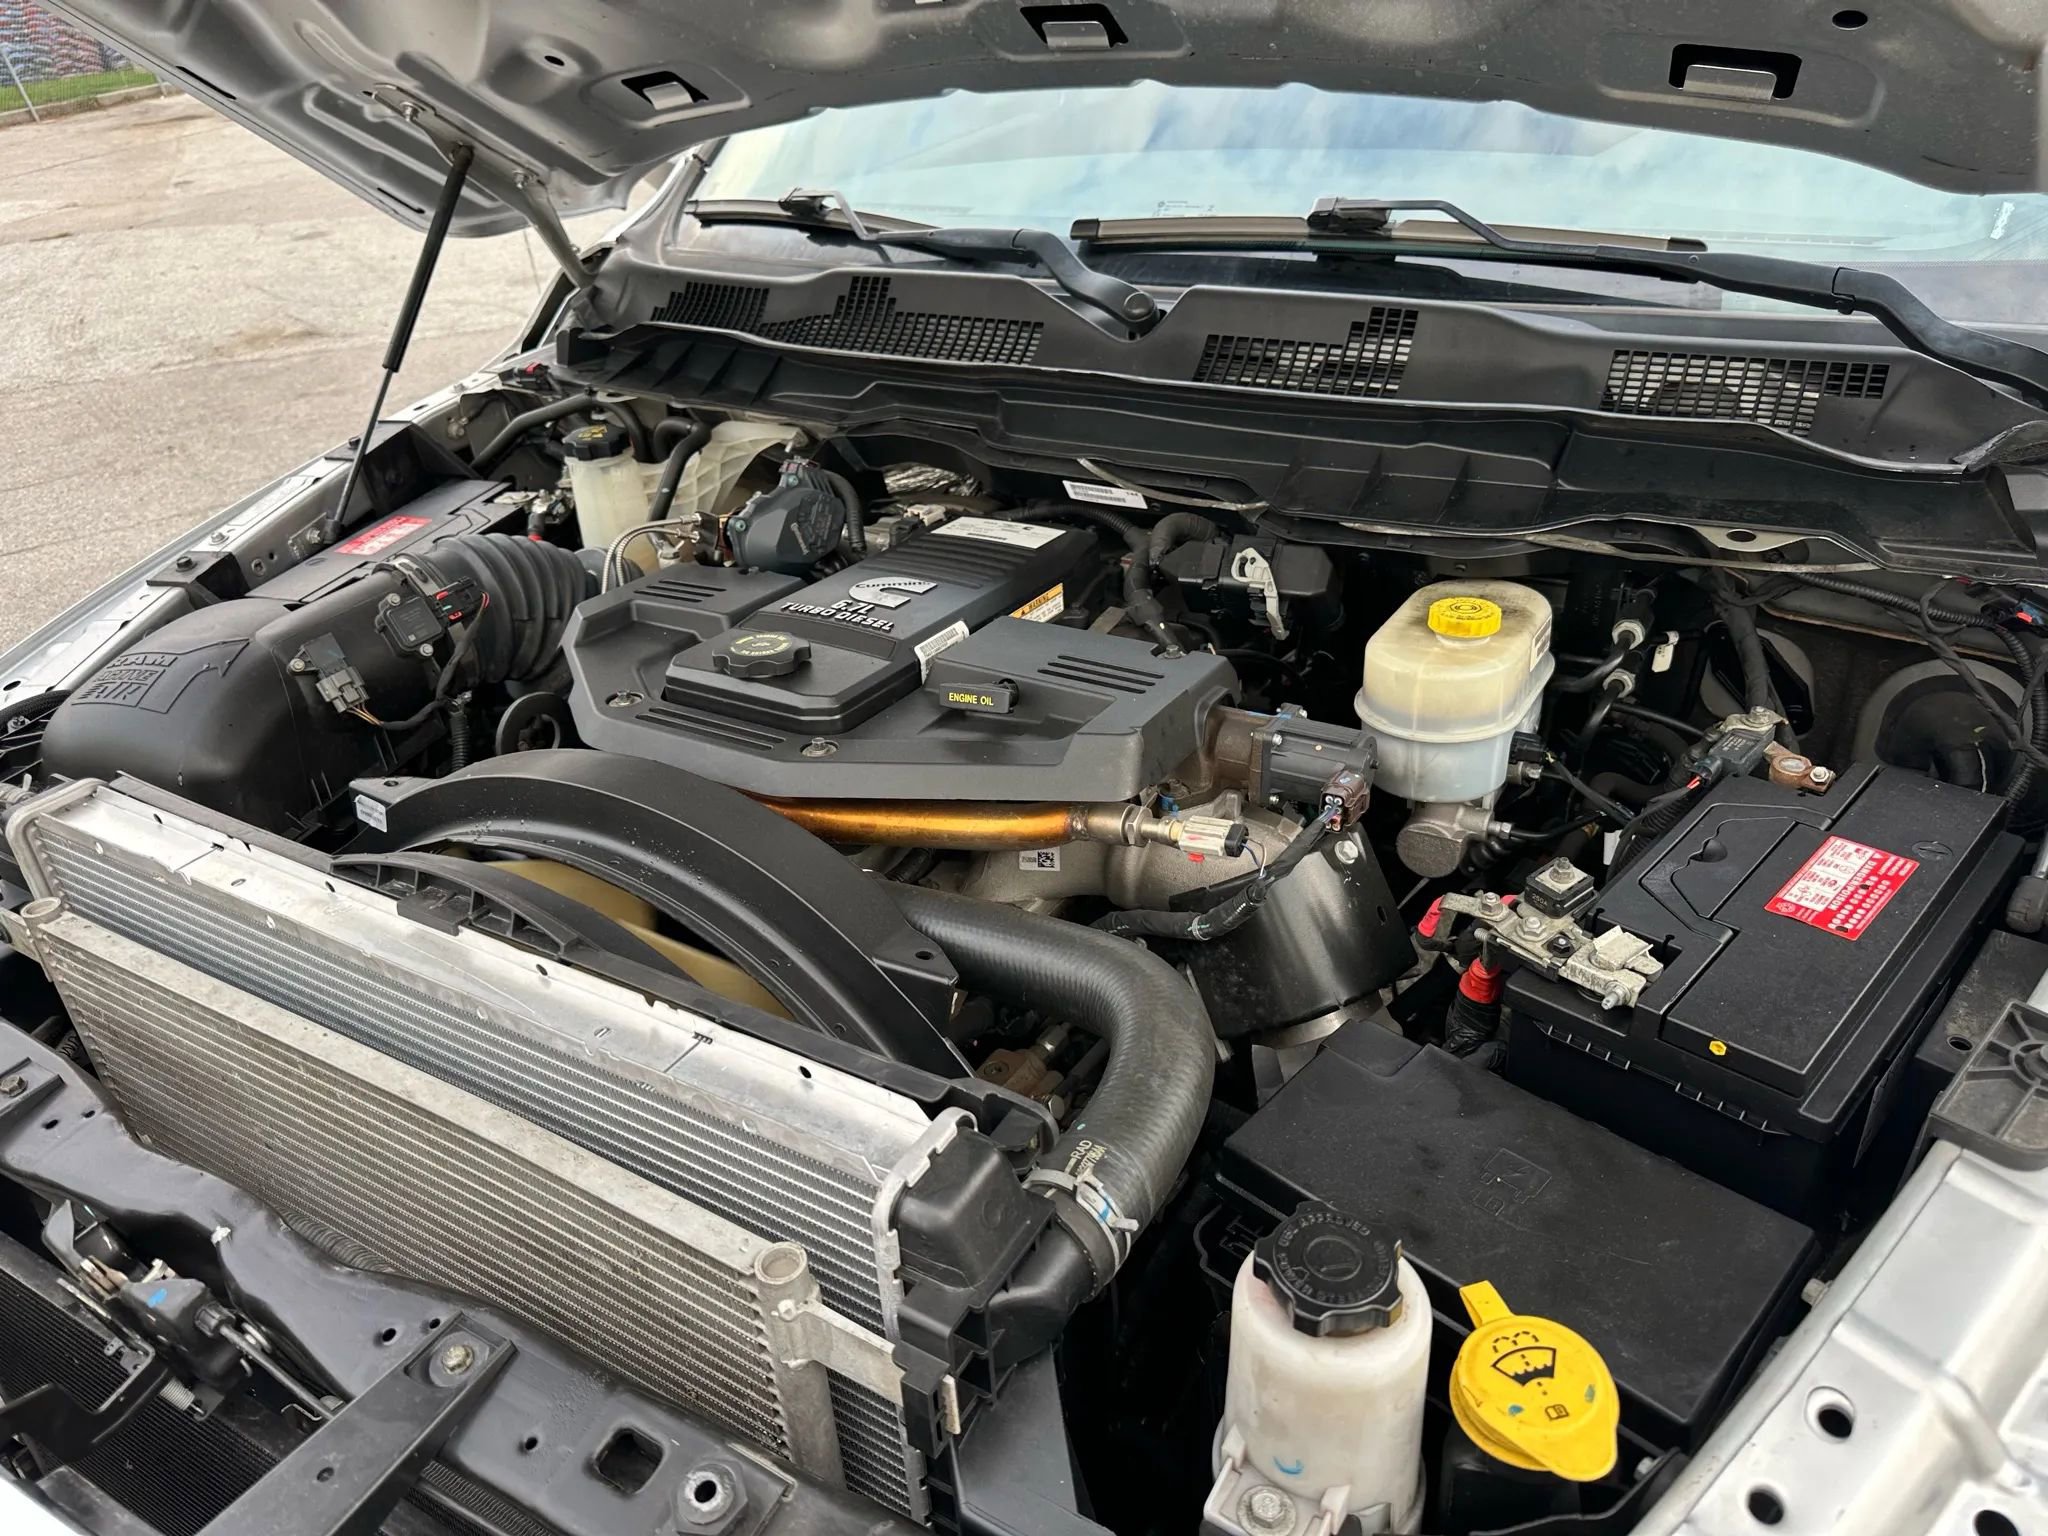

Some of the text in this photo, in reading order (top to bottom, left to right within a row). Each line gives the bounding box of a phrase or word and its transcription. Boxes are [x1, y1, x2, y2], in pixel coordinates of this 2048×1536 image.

[831, 599, 875, 614] 6.7L
[781, 602, 895, 631] TURBO DIESEL
[106, 655, 178, 668] RAM
[97, 669, 159, 681] ACTIVE
[80, 681, 148, 700] AIR
[948, 692, 994, 706] ENGINE OIL
[1070, 1140, 1092, 1160] RAD
